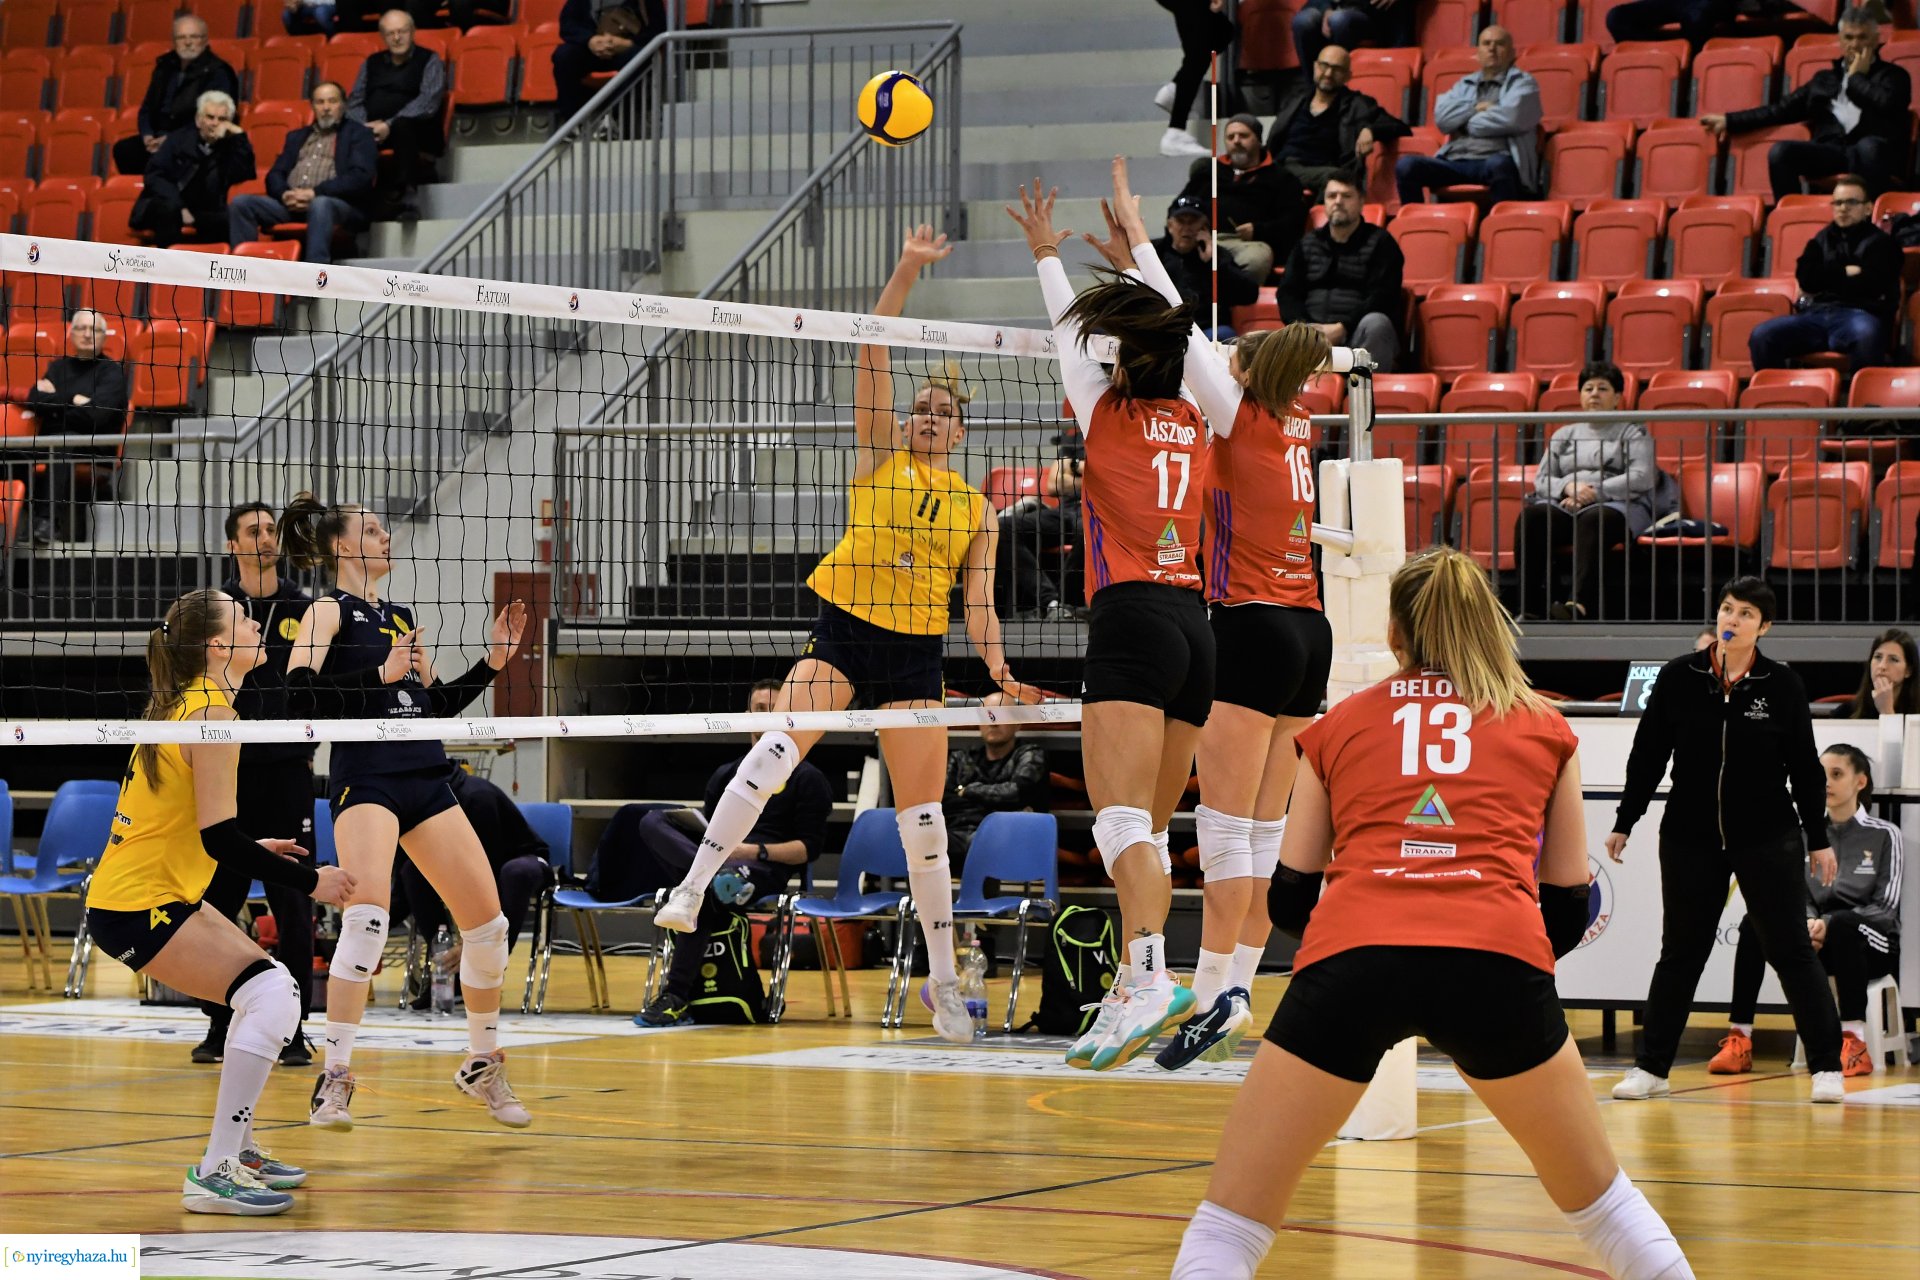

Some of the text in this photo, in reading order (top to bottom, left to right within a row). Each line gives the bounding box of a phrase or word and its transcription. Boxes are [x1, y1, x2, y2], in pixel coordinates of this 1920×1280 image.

[209, 260, 247, 281] FATUM
[476, 285, 510, 304] FATUM
[711, 306, 742, 325] FATUM
[1151, 450, 1191, 511] 17
[1284, 444, 1315, 503] 16
[916, 491, 942, 524] 11
[1159, 552, 1183, 560] STRABAG
[200, 724, 232, 740] FATUM
[467, 722, 497, 736] FATUM
[1392, 702, 1473, 776] 13
[150, 907, 172, 931] 4
